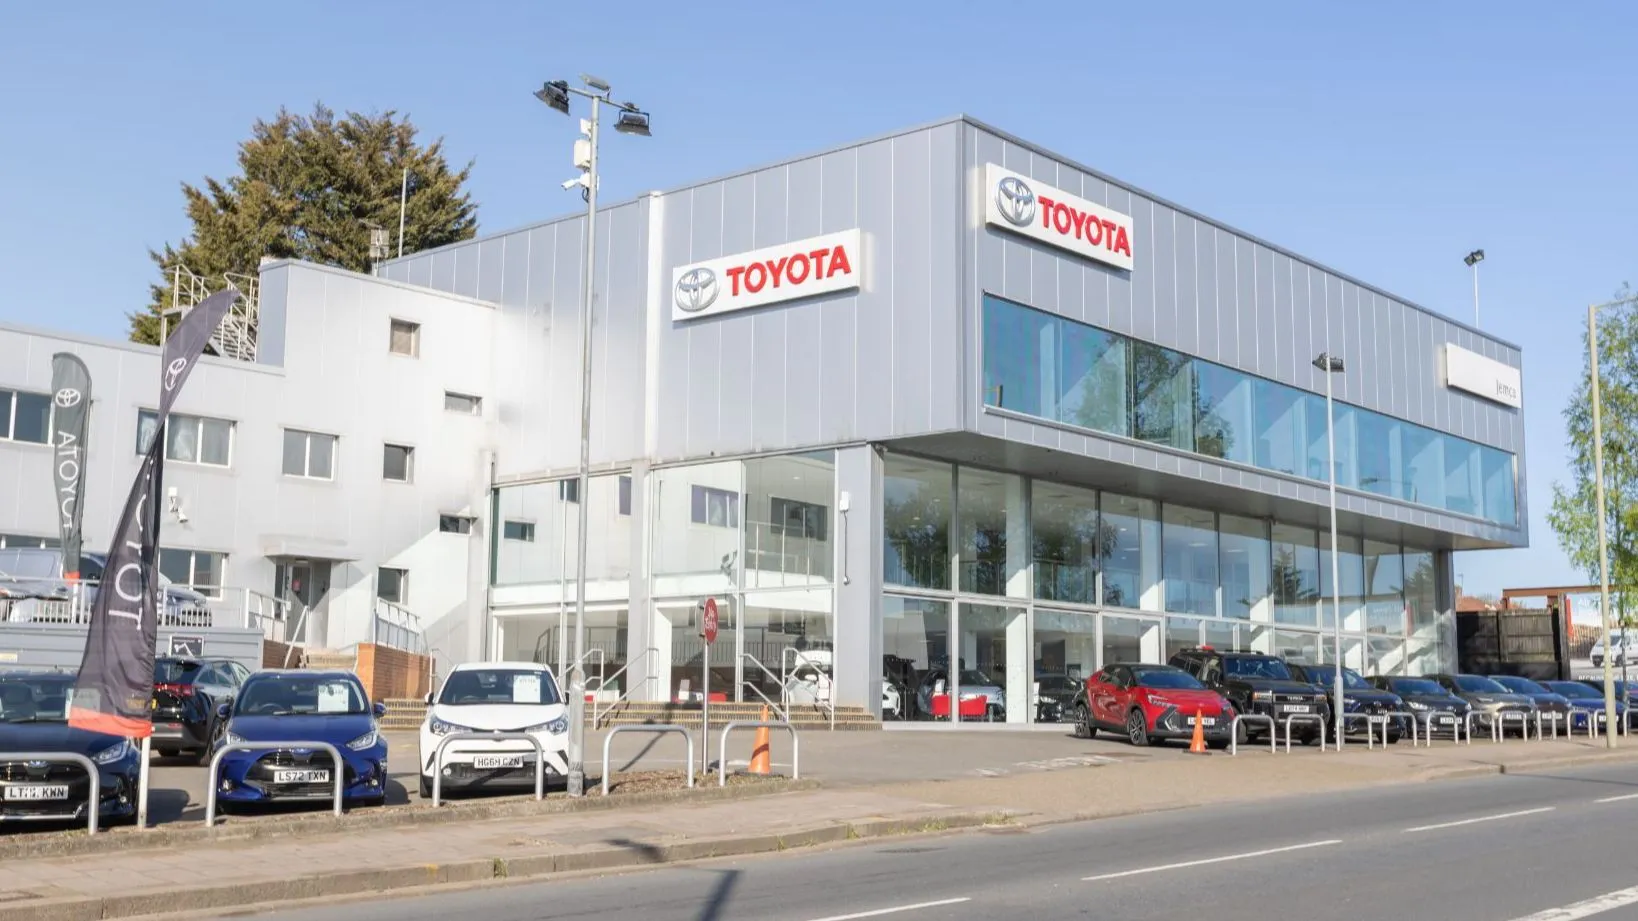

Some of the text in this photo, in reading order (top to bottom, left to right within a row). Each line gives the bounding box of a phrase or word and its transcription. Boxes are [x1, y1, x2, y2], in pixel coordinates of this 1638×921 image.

[1038, 195, 1131, 257] TOYOTA
[726, 245, 852, 296] TOYOTA
[279, 771, 326, 781] LS72 TXN
